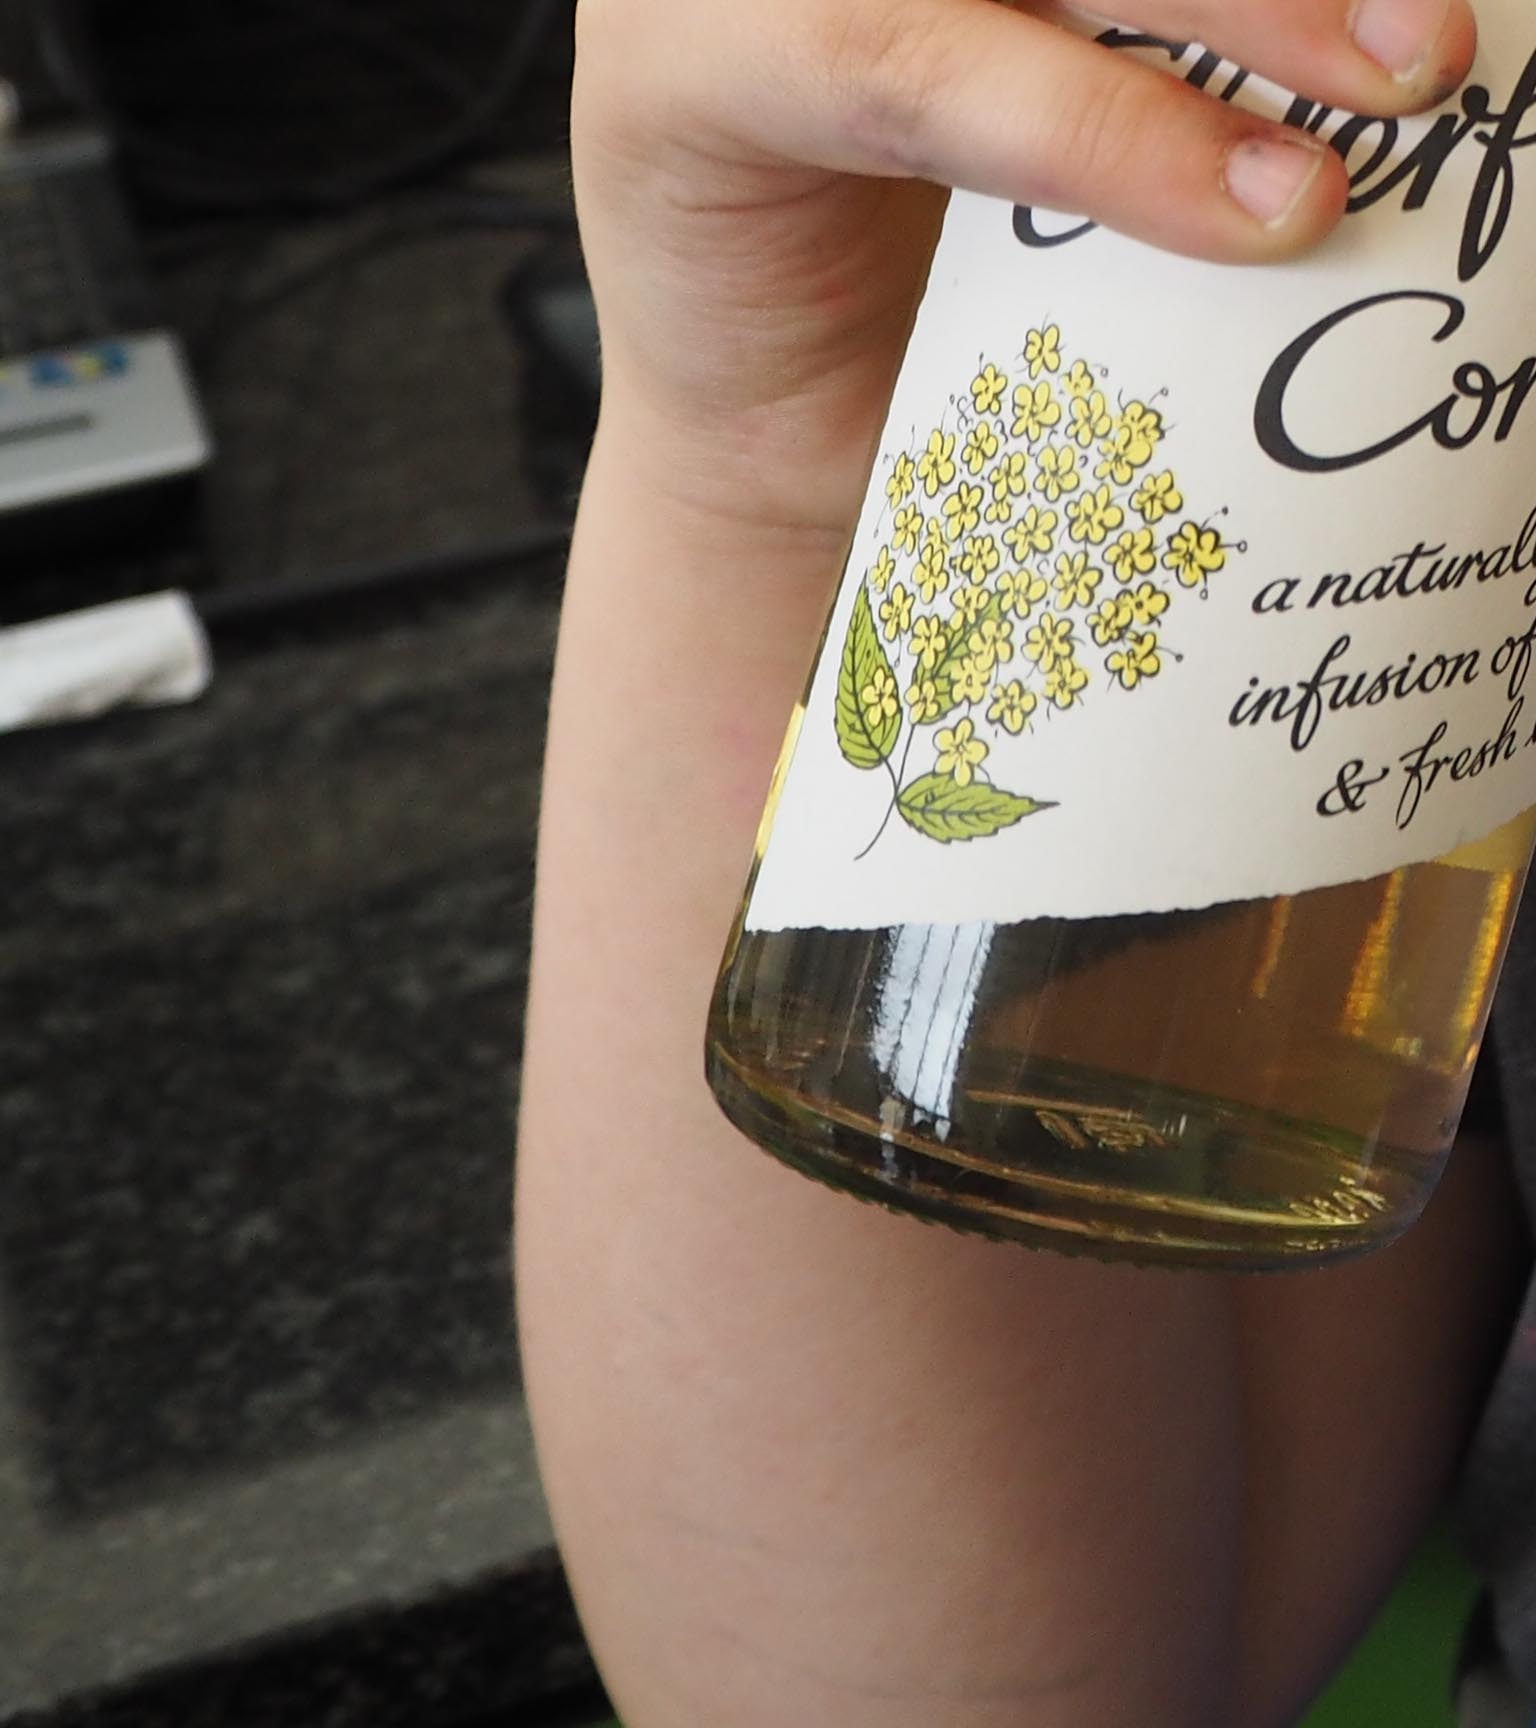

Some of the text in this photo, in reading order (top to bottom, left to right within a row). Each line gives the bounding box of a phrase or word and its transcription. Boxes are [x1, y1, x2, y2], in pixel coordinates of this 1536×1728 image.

[1252, 578, 1298, 616] a
[1228, 634, 1480, 751] infusion
[1315, 758, 1390, 818] &
[1393, 694, 1518, 832] fresh
